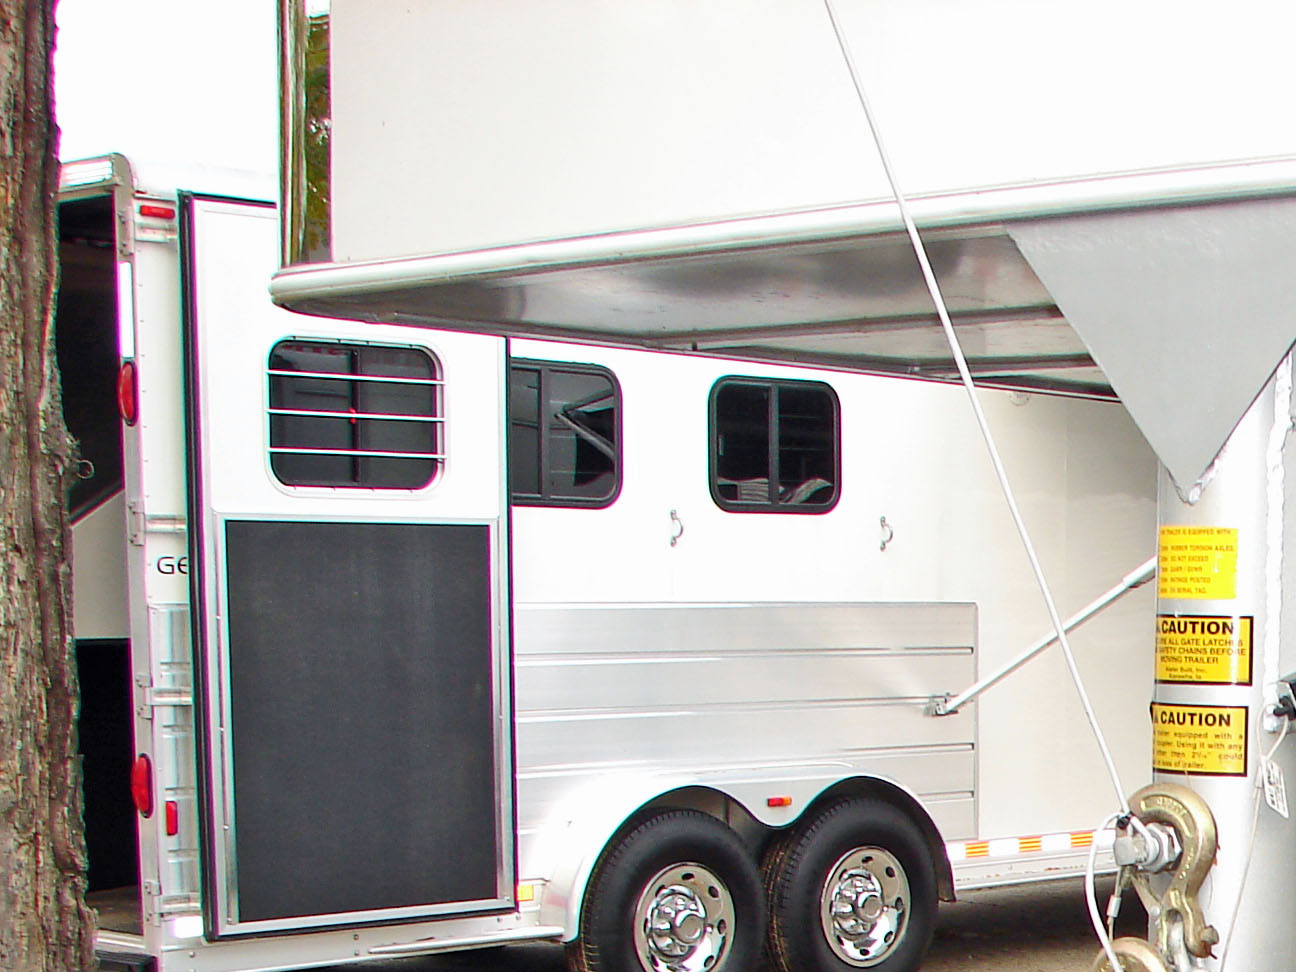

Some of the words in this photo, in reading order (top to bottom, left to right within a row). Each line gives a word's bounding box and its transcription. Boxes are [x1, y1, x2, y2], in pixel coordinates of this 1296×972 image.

[1161, 620, 1234, 635] CAUTION
[1180, 638, 1201, 646] GATE
[1202, 639, 1244, 647] LATCHS
[1178, 647, 1207, 655] CHAINS
[1184, 656, 1219, 664] TRAILER
[1160, 711, 1231, 727] CAUTION
[1173, 731, 1209, 740] equipped
[1214, 732, 1232, 740] with
[1176, 740, 1197, 750] Using
[1208, 742, 1225, 750] with
[1228, 743, 1243, 752] any
